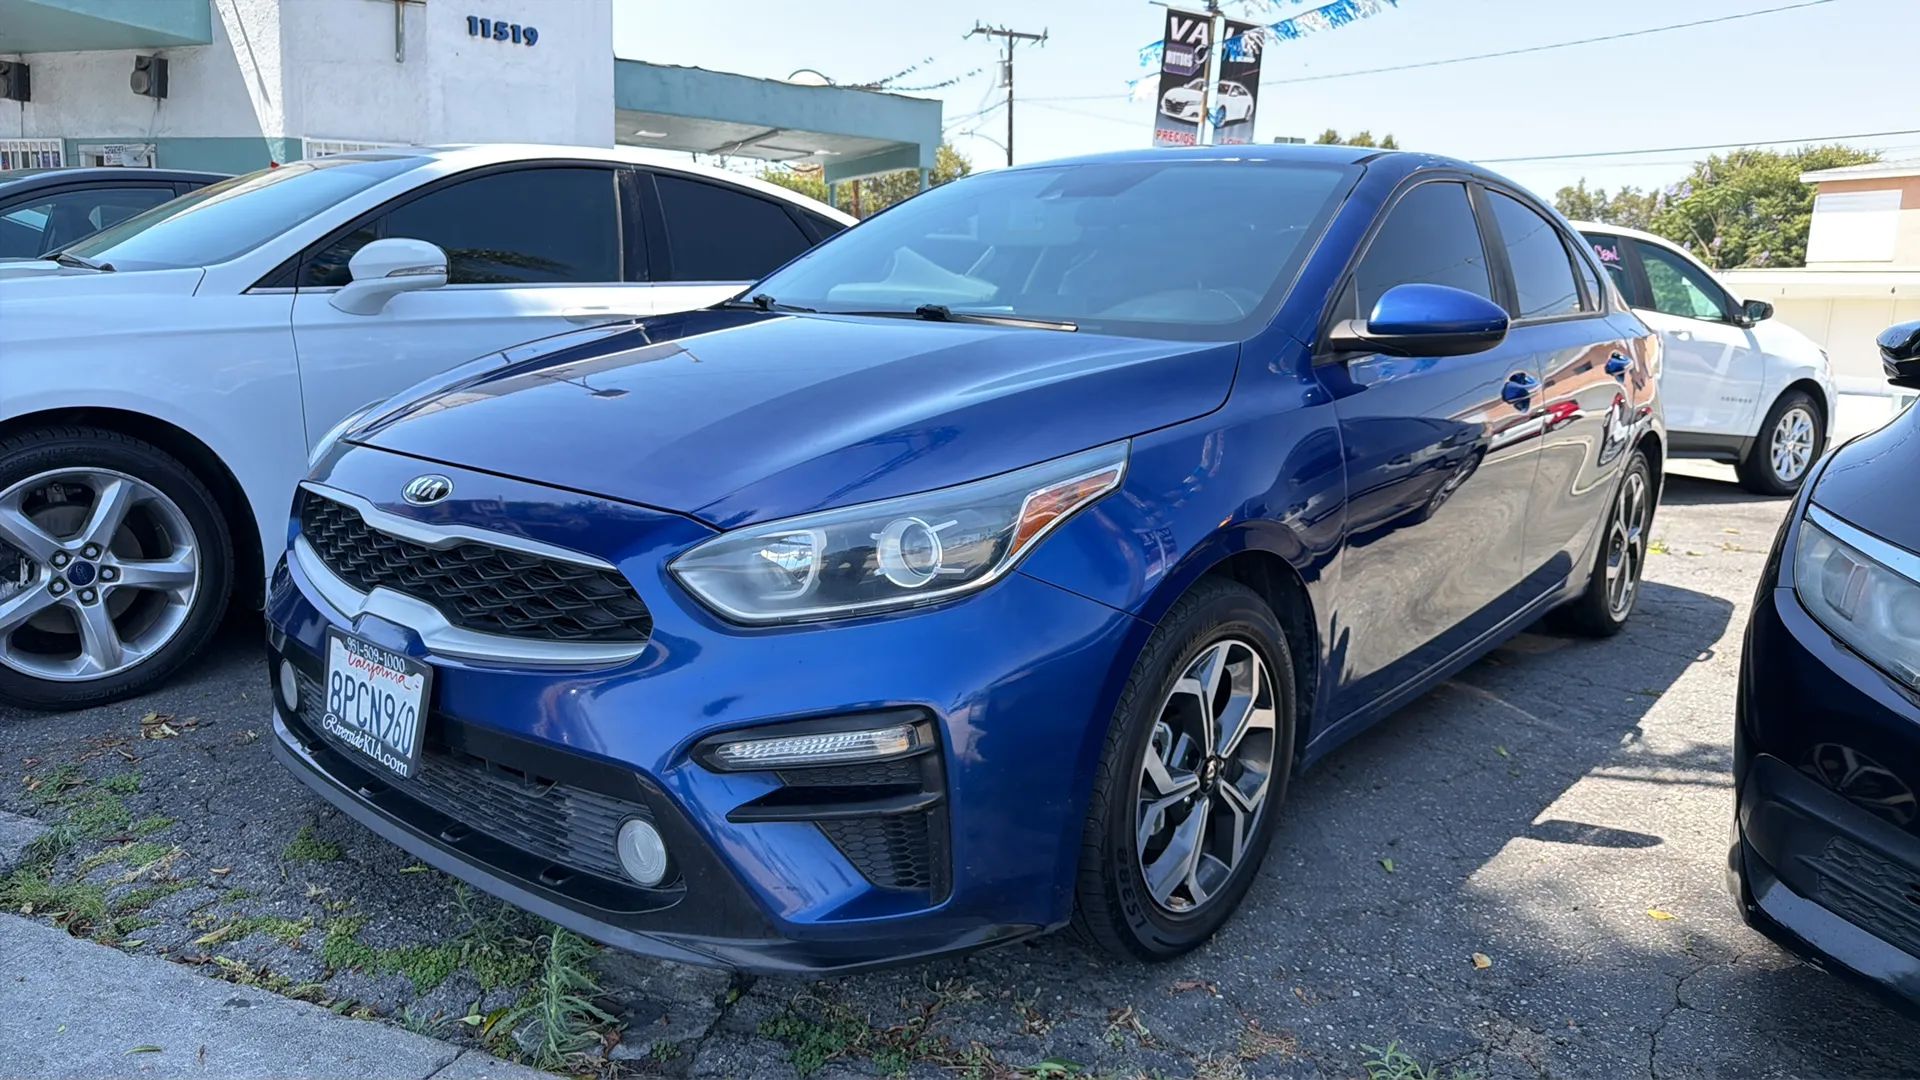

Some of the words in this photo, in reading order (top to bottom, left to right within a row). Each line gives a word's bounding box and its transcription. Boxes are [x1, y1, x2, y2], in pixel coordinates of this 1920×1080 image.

[466, 15, 539, 46] 11519
[405, 477, 443, 500] KIA
[329, 669, 416, 756] 8PCN960
[322, 712, 408, 777] RiversideKIA.com
